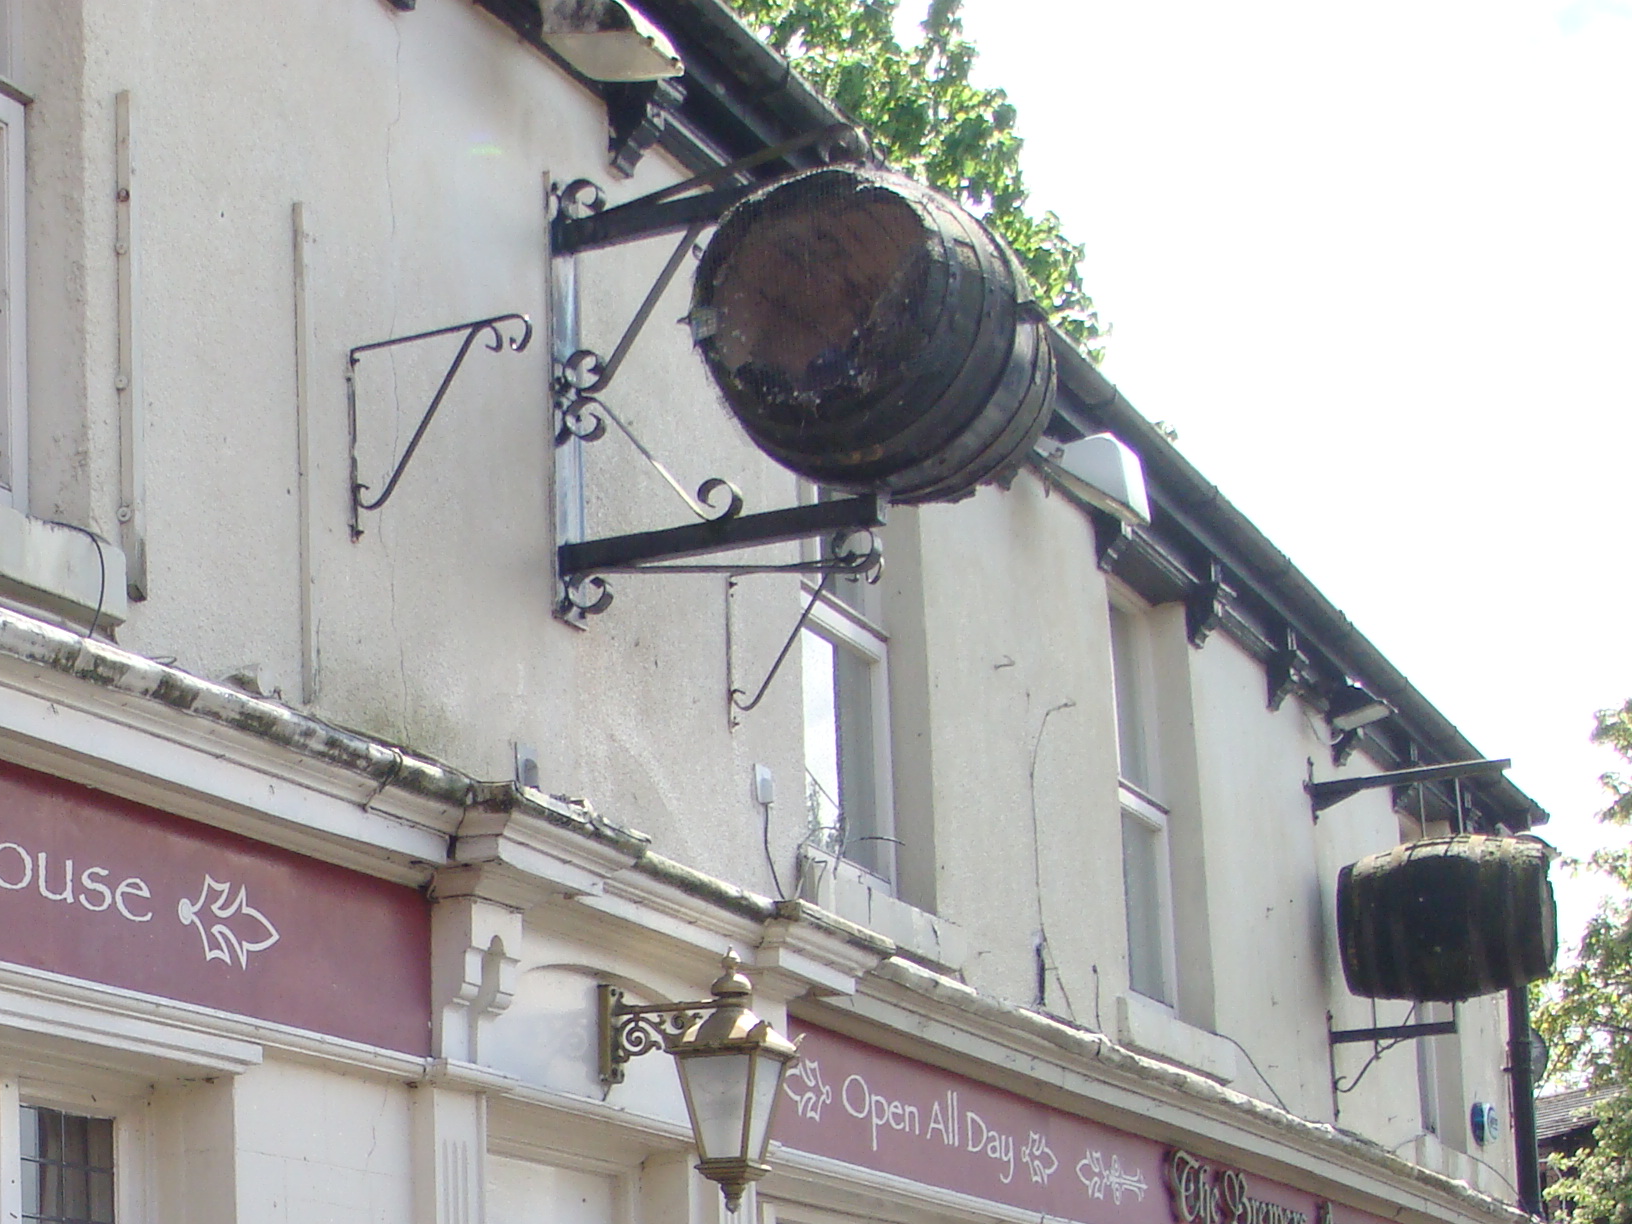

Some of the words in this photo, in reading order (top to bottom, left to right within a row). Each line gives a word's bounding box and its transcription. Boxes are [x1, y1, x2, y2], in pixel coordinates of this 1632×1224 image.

[842, 1074, 919, 1151] Open
[926, 1090, 959, 1147] All
[966, 1111, 1015, 1184] Day
